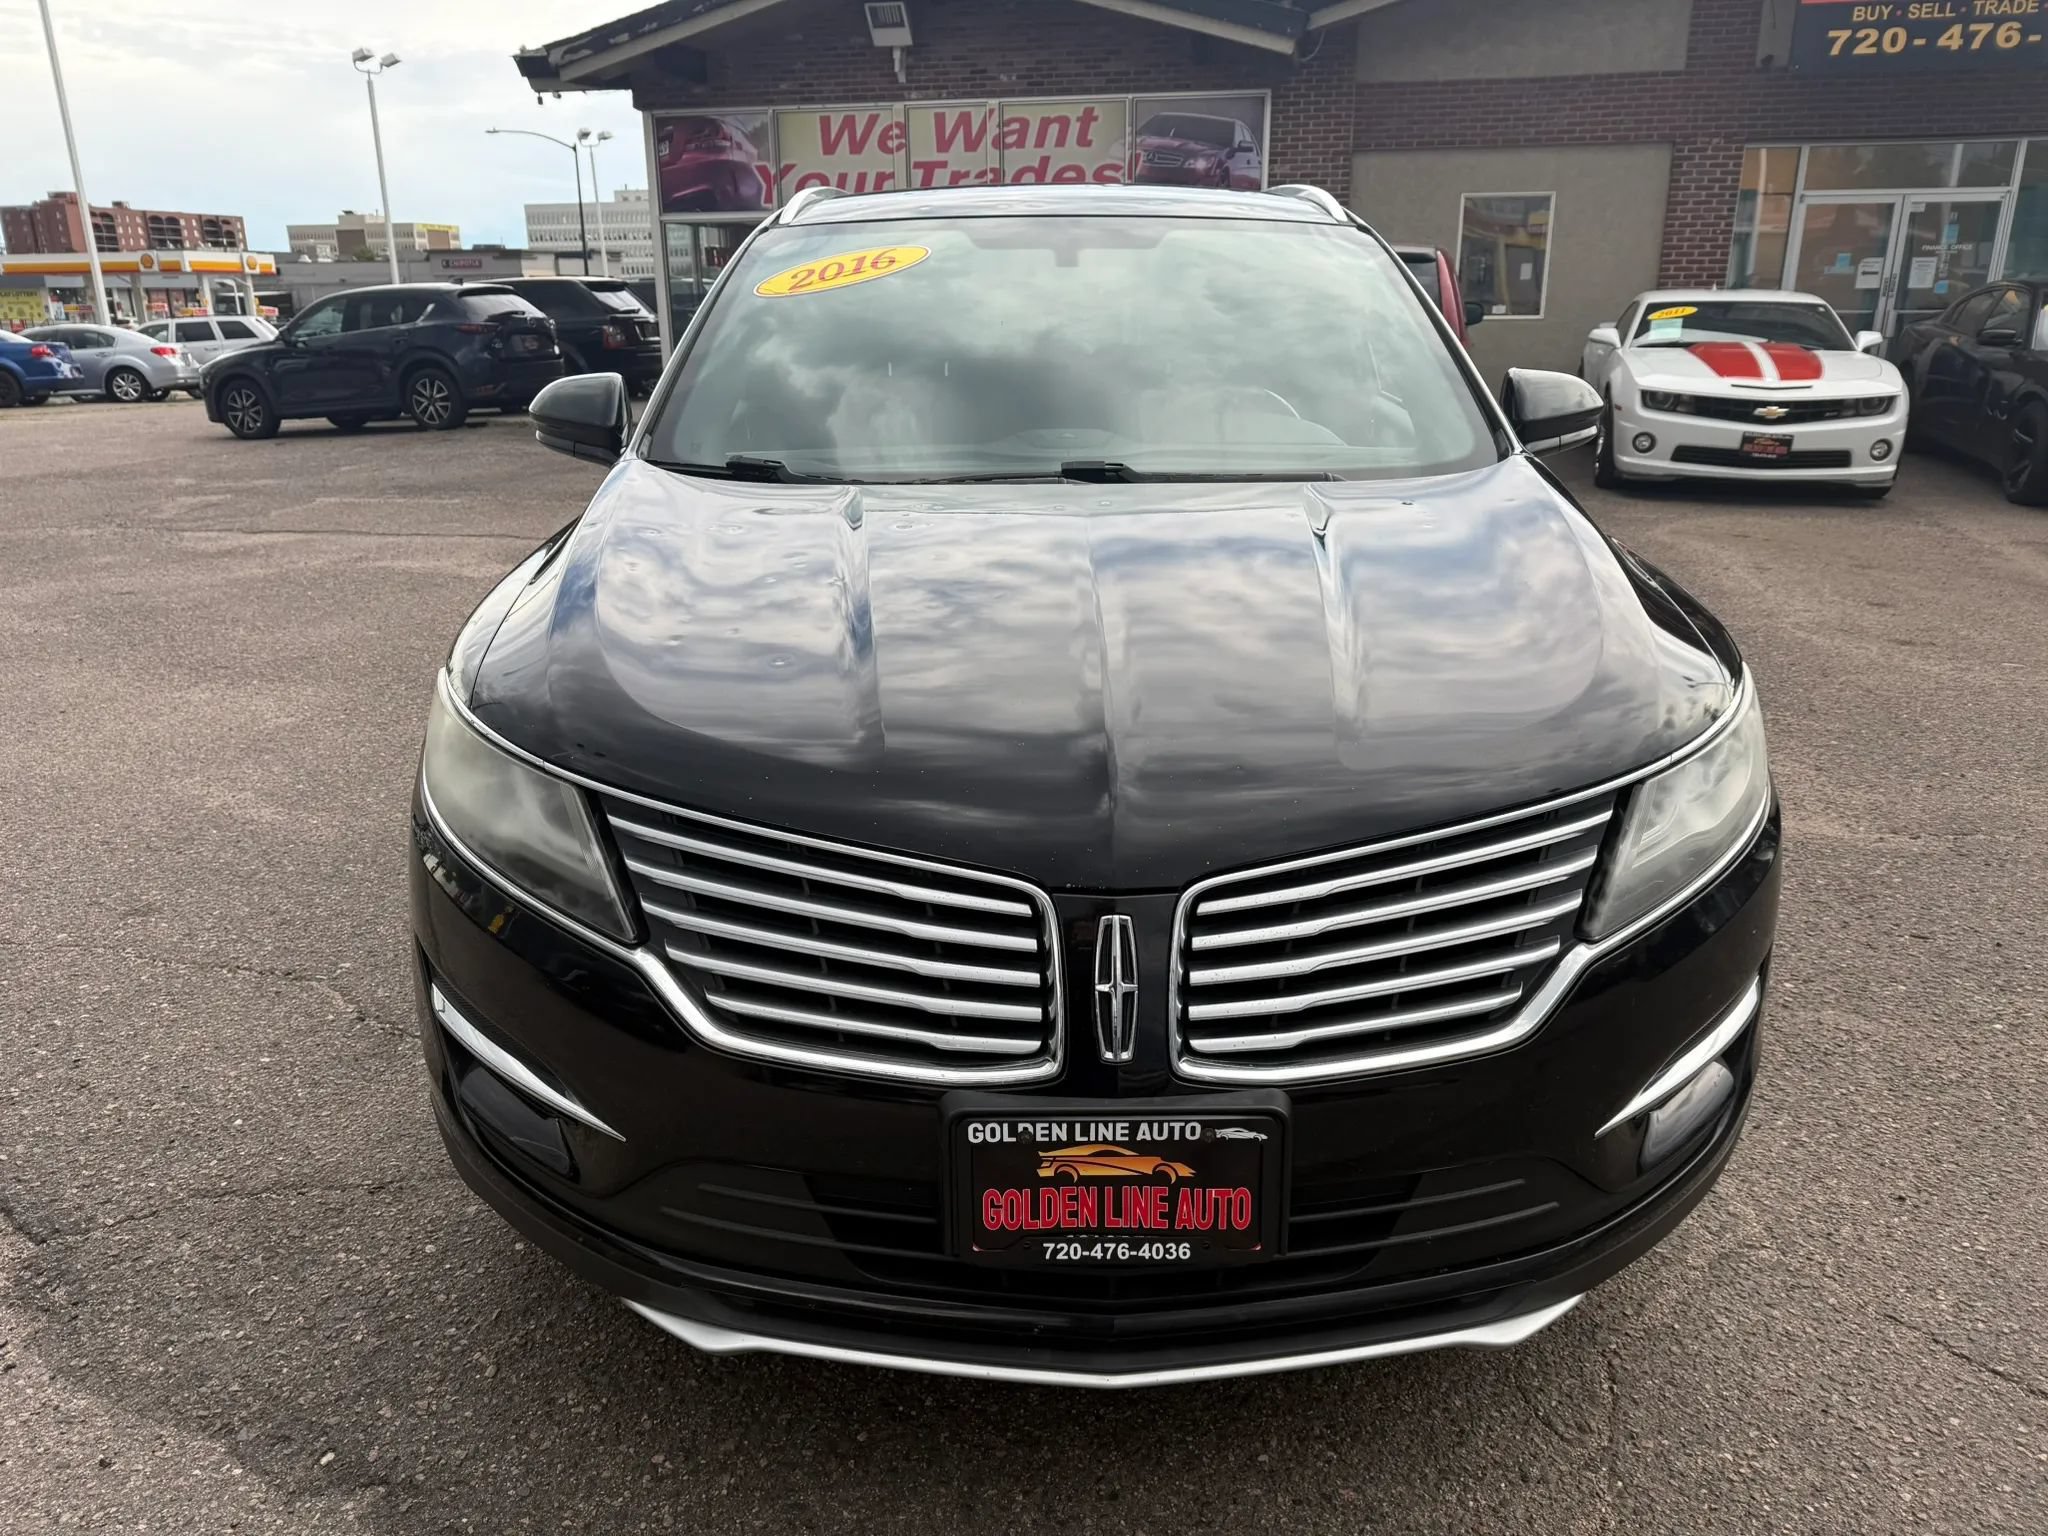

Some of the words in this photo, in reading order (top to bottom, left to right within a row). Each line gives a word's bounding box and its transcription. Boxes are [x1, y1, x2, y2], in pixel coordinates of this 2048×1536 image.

[1852, 5, 1893, 22] BUY
[1908, 3, 1957, 19] SELL
[1973, 0, 2040, 16] TRADE
[818, 112, 907, 156] We
[933, 106, 1099, 153] Want
[787, 248, 898, 291] 2016
[1075, 1122, 1129, 1142] LINE
[1136, 1121, 1201, 1141] AUTO
[982, 1186, 1097, 1230] GOLDEN
[1104, 1185, 1169, 1229] LINE
[1175, 1187, 1252, 1230] AUTO
[1043, 1242, 1191, 1260] 720-476-4036
